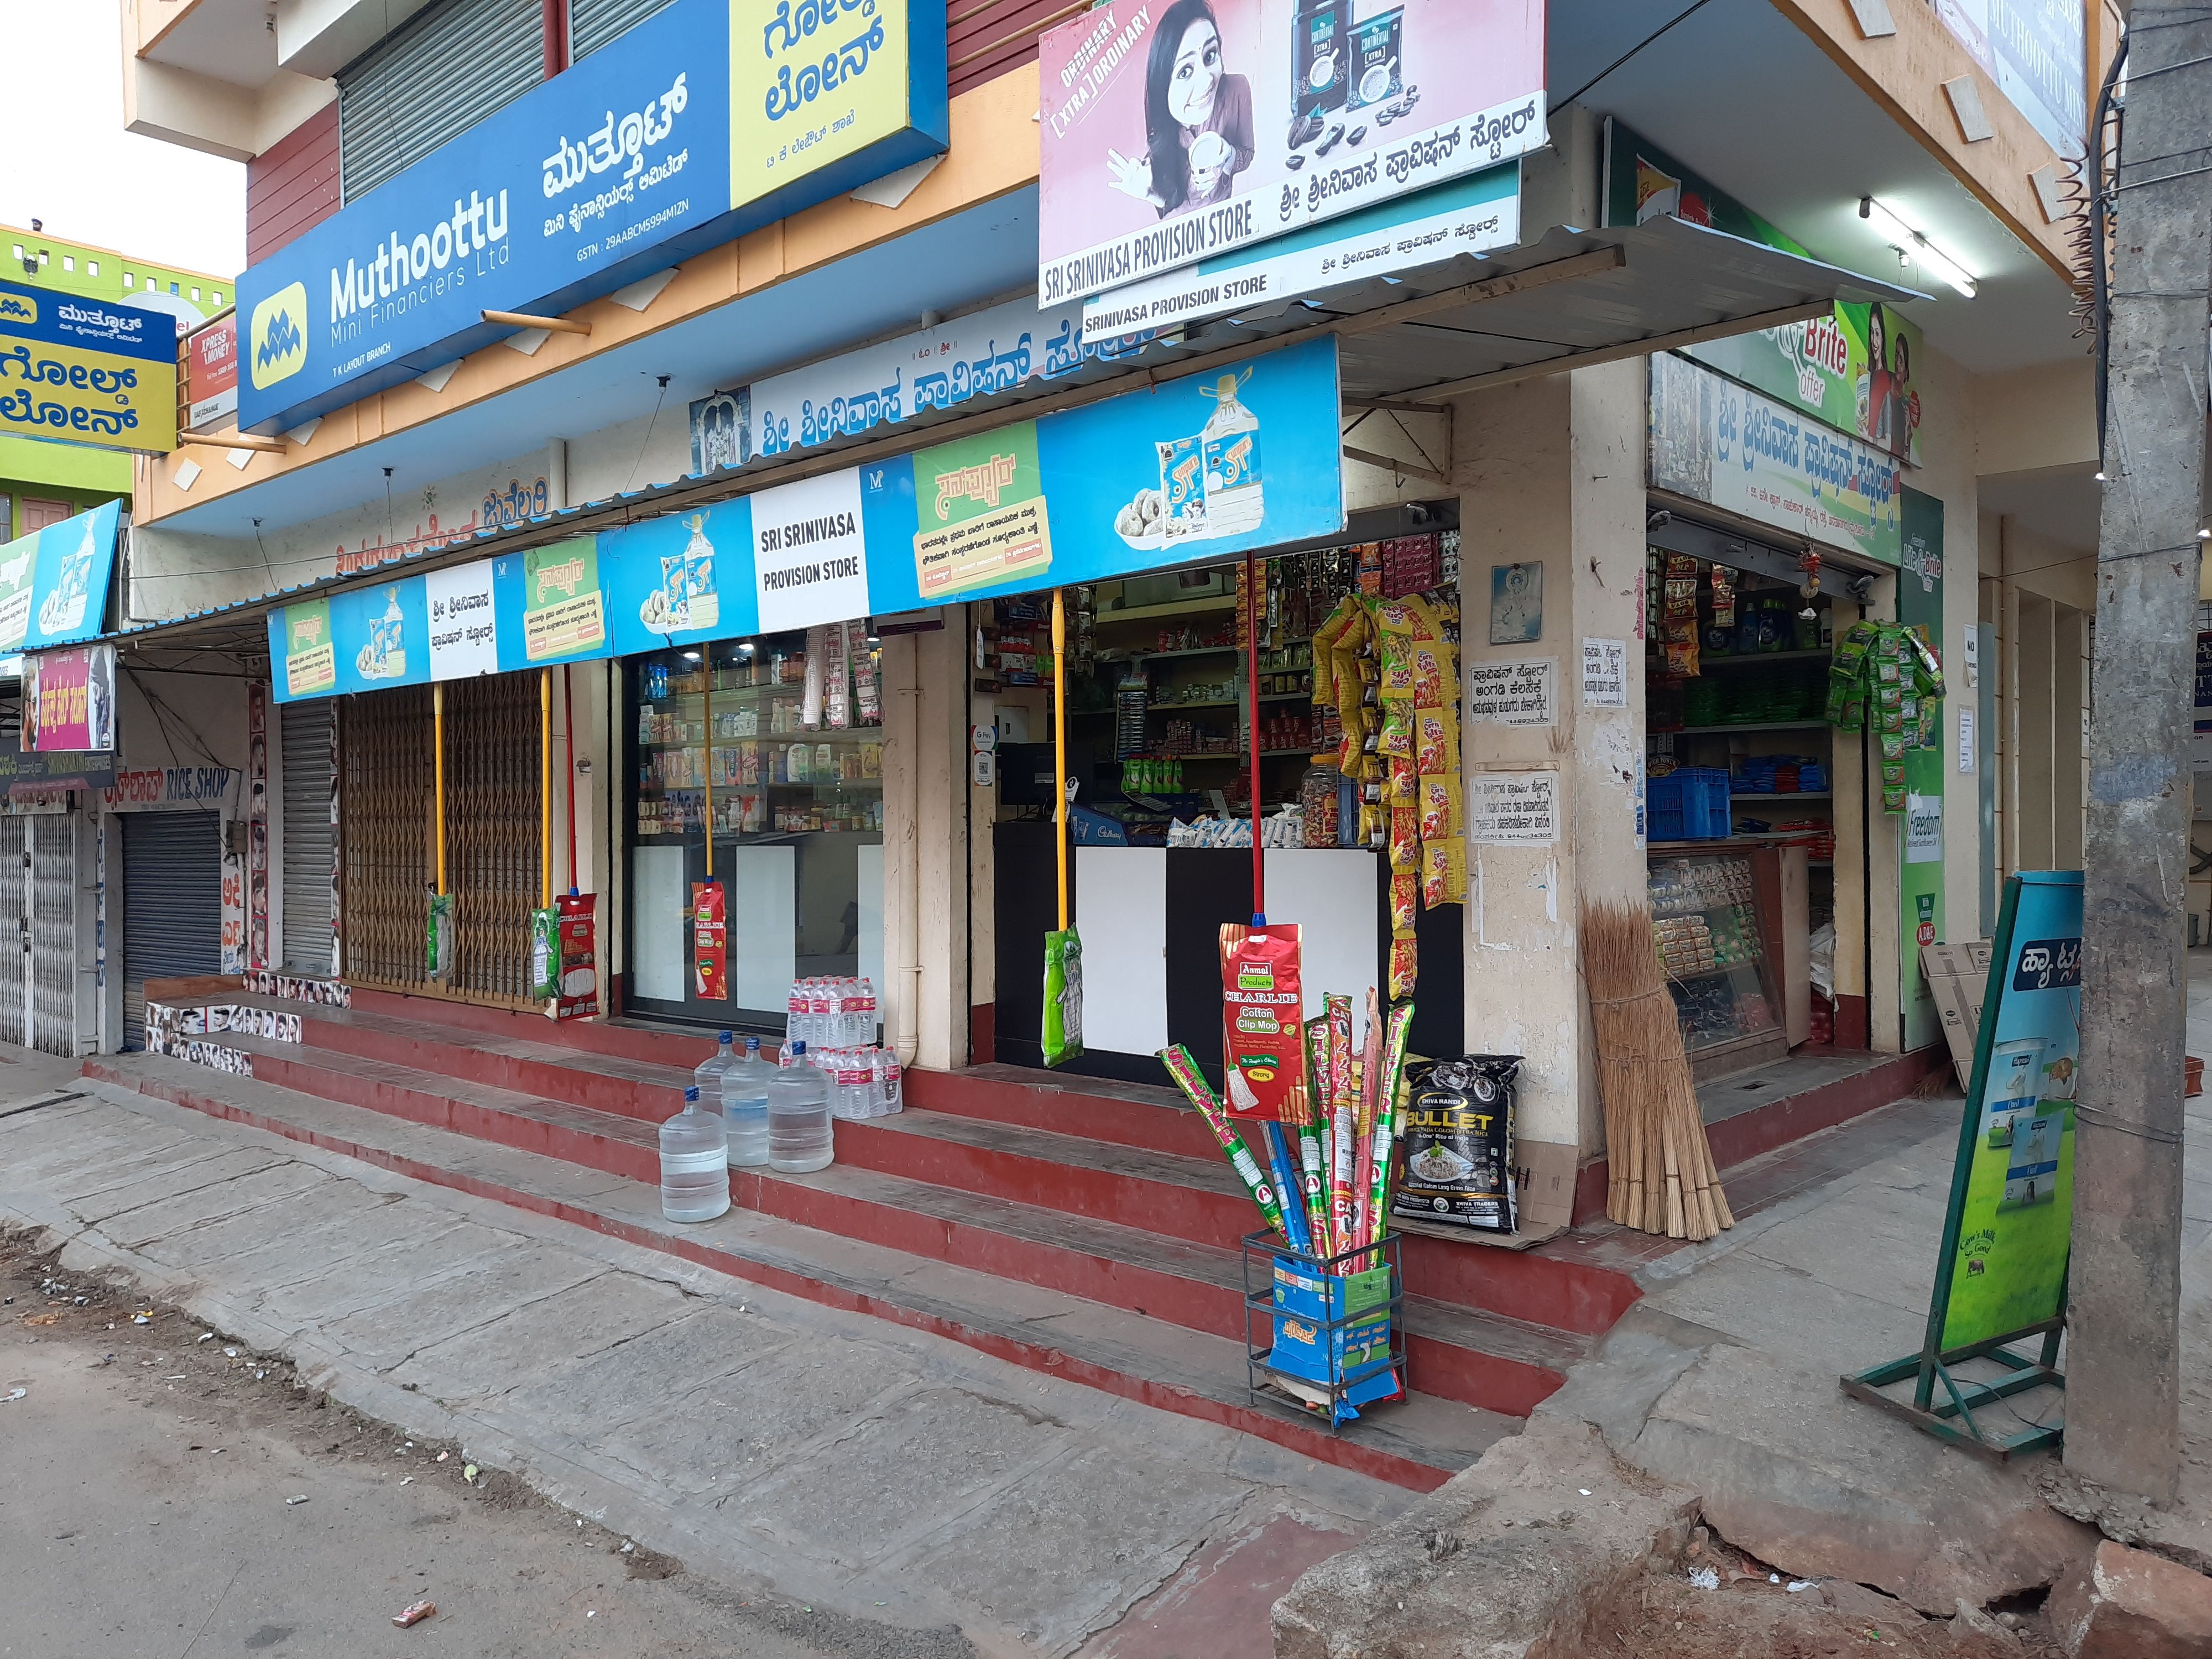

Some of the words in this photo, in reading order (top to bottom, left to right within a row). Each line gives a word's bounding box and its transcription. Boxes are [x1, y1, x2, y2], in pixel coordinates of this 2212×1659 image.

[1060, 9, 1117, 88] ORDINARY
[765, 15, 884, 121] ಲೋನ್
[779, 145, 787, 160] ಕೆ
[792, 125, 826, 154] ಲೇಔಟ್
[832, 109, 855, 133] ಶಾಖೆ
[1280, 184, 1300, 222] ಶ್ರೀ
[1307, 152, 1377, 212] ಶ್ರೀನಿವಾಸ
[1386, 126, 1460, 184] ಪ್ರಾವಿಷನ್
[1470, 100, 1535, 160] ಸ್ಟೋರ್
[544, 213, 565, 237] ಮಿನಿ
[639, 148, 688, 190] ಲಿಮಿಟೆಡ್
[330, 188, 508, 324] Muthoottu
[577, 242, 598, 262] GSTN
[1045, 263, 1063, 301] SRI
[1066, 242, 1130, 294] SRINIVASA
[1134, 216, 1206, 270] PROVISION
[1209, 200, 1252, 243] STORE
[1321, 259, 1335, 274] ಶ್ರೀ
[1342, 243, 1390, 269] ಶ್ರೀನಿವಾಸ
[1397, 228, 1448, 254] ಪ್ರಾವಿಷನ್
[1454, 215, 1498, 240] ಸ್ಟೋರ್ಸ್
[331, 317, 361, 349] Mini
[370, 264, 465, 329] Financiers
[476, 237, 509, 277] Ltd
[1085, 301, 1150, 333] SRINIVASA
[1152, 286, 1220, 319] PROVISION
[1223, 274, 1267, 301] STORE
[201, 328, 227, 354] XPRESS
[204, 341, 230, 366] MONEY
[1804, 318, 1846, 374] Brite
[332, 367, 337, 377] T
[337, 364, 343, 375] K
[343, 352, 366, 373] LAYOUT
[366, 341, 390, 364] BRANCH
[0, 346, 138, 405] ಗೋಲ್ಡ್
[1801, 373, 1824, 404] offer
[0, 388, 138, 435] ಲೋನ್
[1717, 379, 1737, 463] ಶ್ರೀ
[1743, 389, 1799, 473] ಶ್ರೀನಿವಾಸ
[1804, 430, 1853, 501] ಪ್ರಾವಿಷನ್
[760, 528, 781, 552] SRI
[785, 512, 856, 546] SRINIVASA
[764, 563, 820, 592] PROVISION
[823, 555, 859, 582] STORE
[432, 599, 445, 622] ಶ್ರೀ
[448, 589, 489, 619] ಶ್ರೀನಿವಾಸ
[431, 628, 462, 650] ಪ್ರಾವಿಷನ್
[466, 623, 494, 646] ಸ್ಟೋರ್ಸ್
[1967, 640, 1975, 651] NO
[1473, 666, 1512, 683] ಪ್ರಾವಿಷನ್
[1516, 664, 1548, 682] ಸ್ಟೋರ್
[1476, 682, 1505, 696] ಅಂಗಡಿ
[1510, 679, 1542, 700] ಕೆಲಸಕ್ಕೆ
[167, 768, 193, 800] RICE
[195, 767, 229, 799] SHOP
[1098, 826, 1121, 838] Cadbury
[1908, 809, 1940, 837] Freedom
[1240, 977, 1272, 987] Products
[1242, 964, 1269, 974] Anmol
[1225, 991, 1298, 1004] CHARLIE
[1242, 1008, 1272, 1018] Cotton
[1239, 1019, 1255, 1030] Clip
[1258, 1020, 1277, 1030] Mop
[1332, 1008, 1351, 1022] CAT
[1167, 1048, 1238, 1147] SILVER
[1406, 1111, 1494, 1130] BULLET
[1335, 1200, 1352, 1213] CA
[1960, 1229, 1980, 1250] Cow's
[1964, 1250, 1973, 1259] So
[1974, 1244, 1991, 1254] Good
